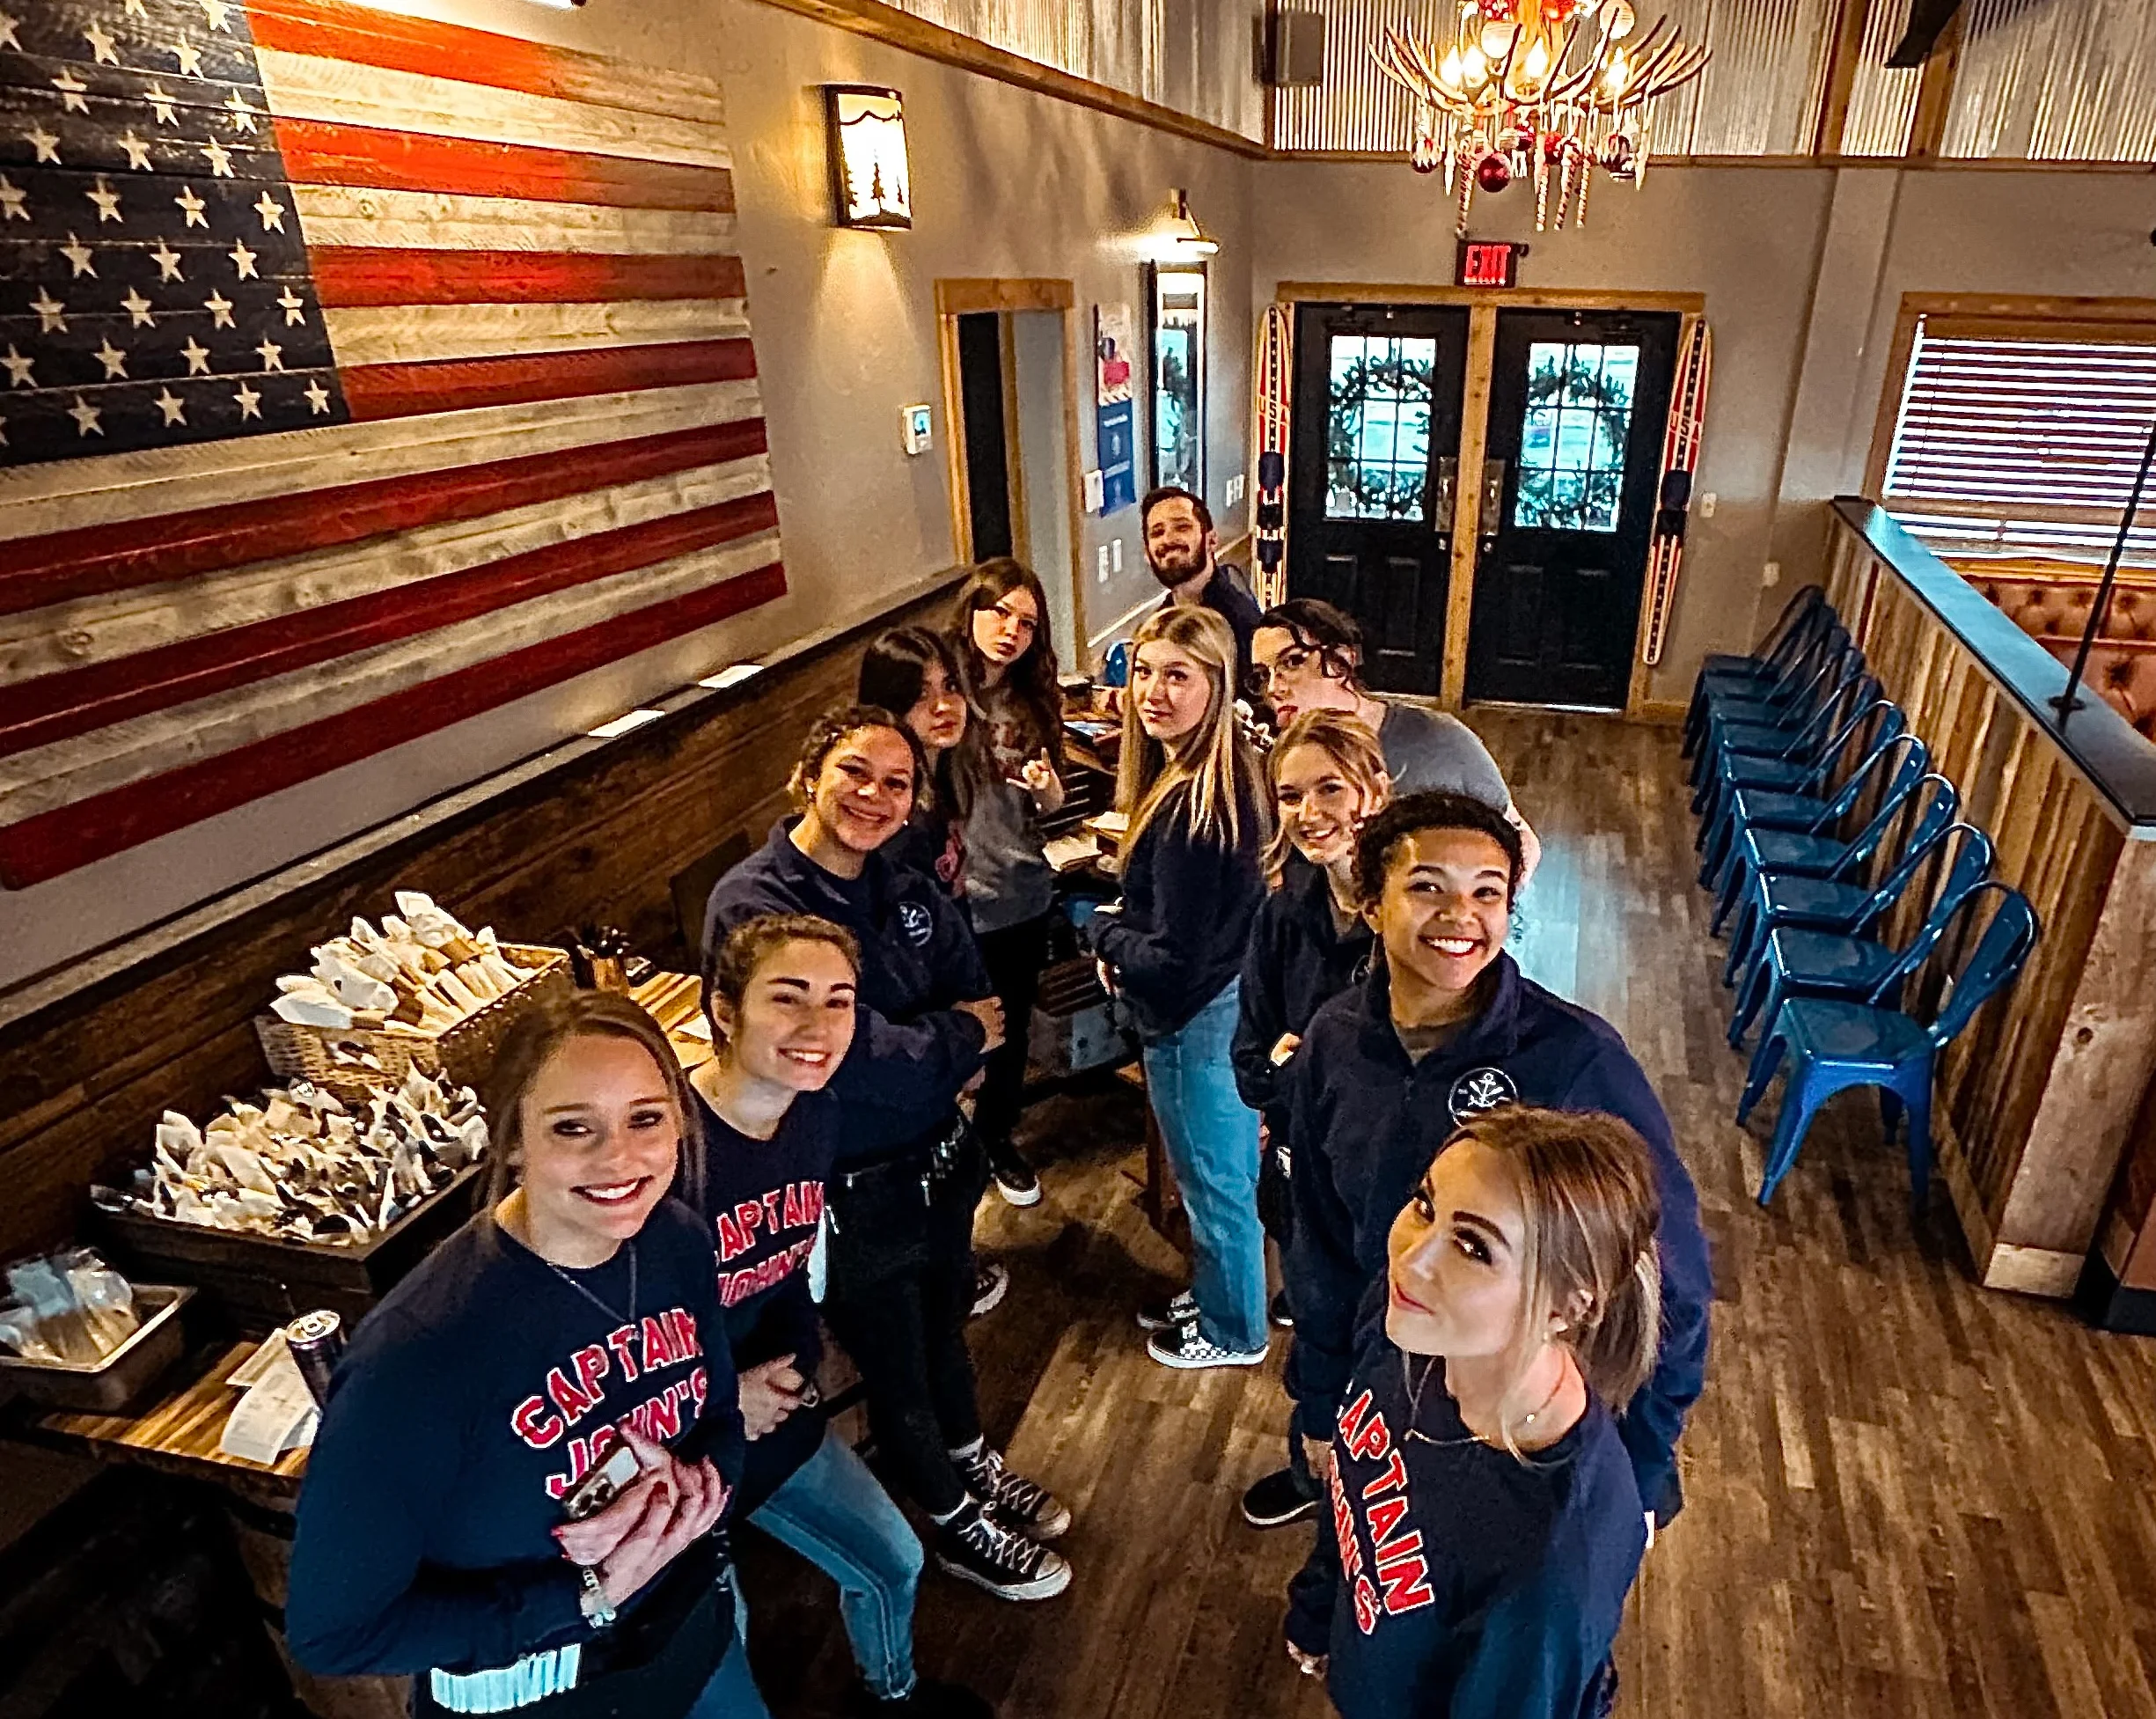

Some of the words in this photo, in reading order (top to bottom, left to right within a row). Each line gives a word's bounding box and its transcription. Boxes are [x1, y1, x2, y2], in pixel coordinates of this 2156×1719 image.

[1463, 245, 1512, 284] EXIT
[715, 1180, 825, 1267] APTAIN
[1336, 1378, 1435, 1616] APTAIN
